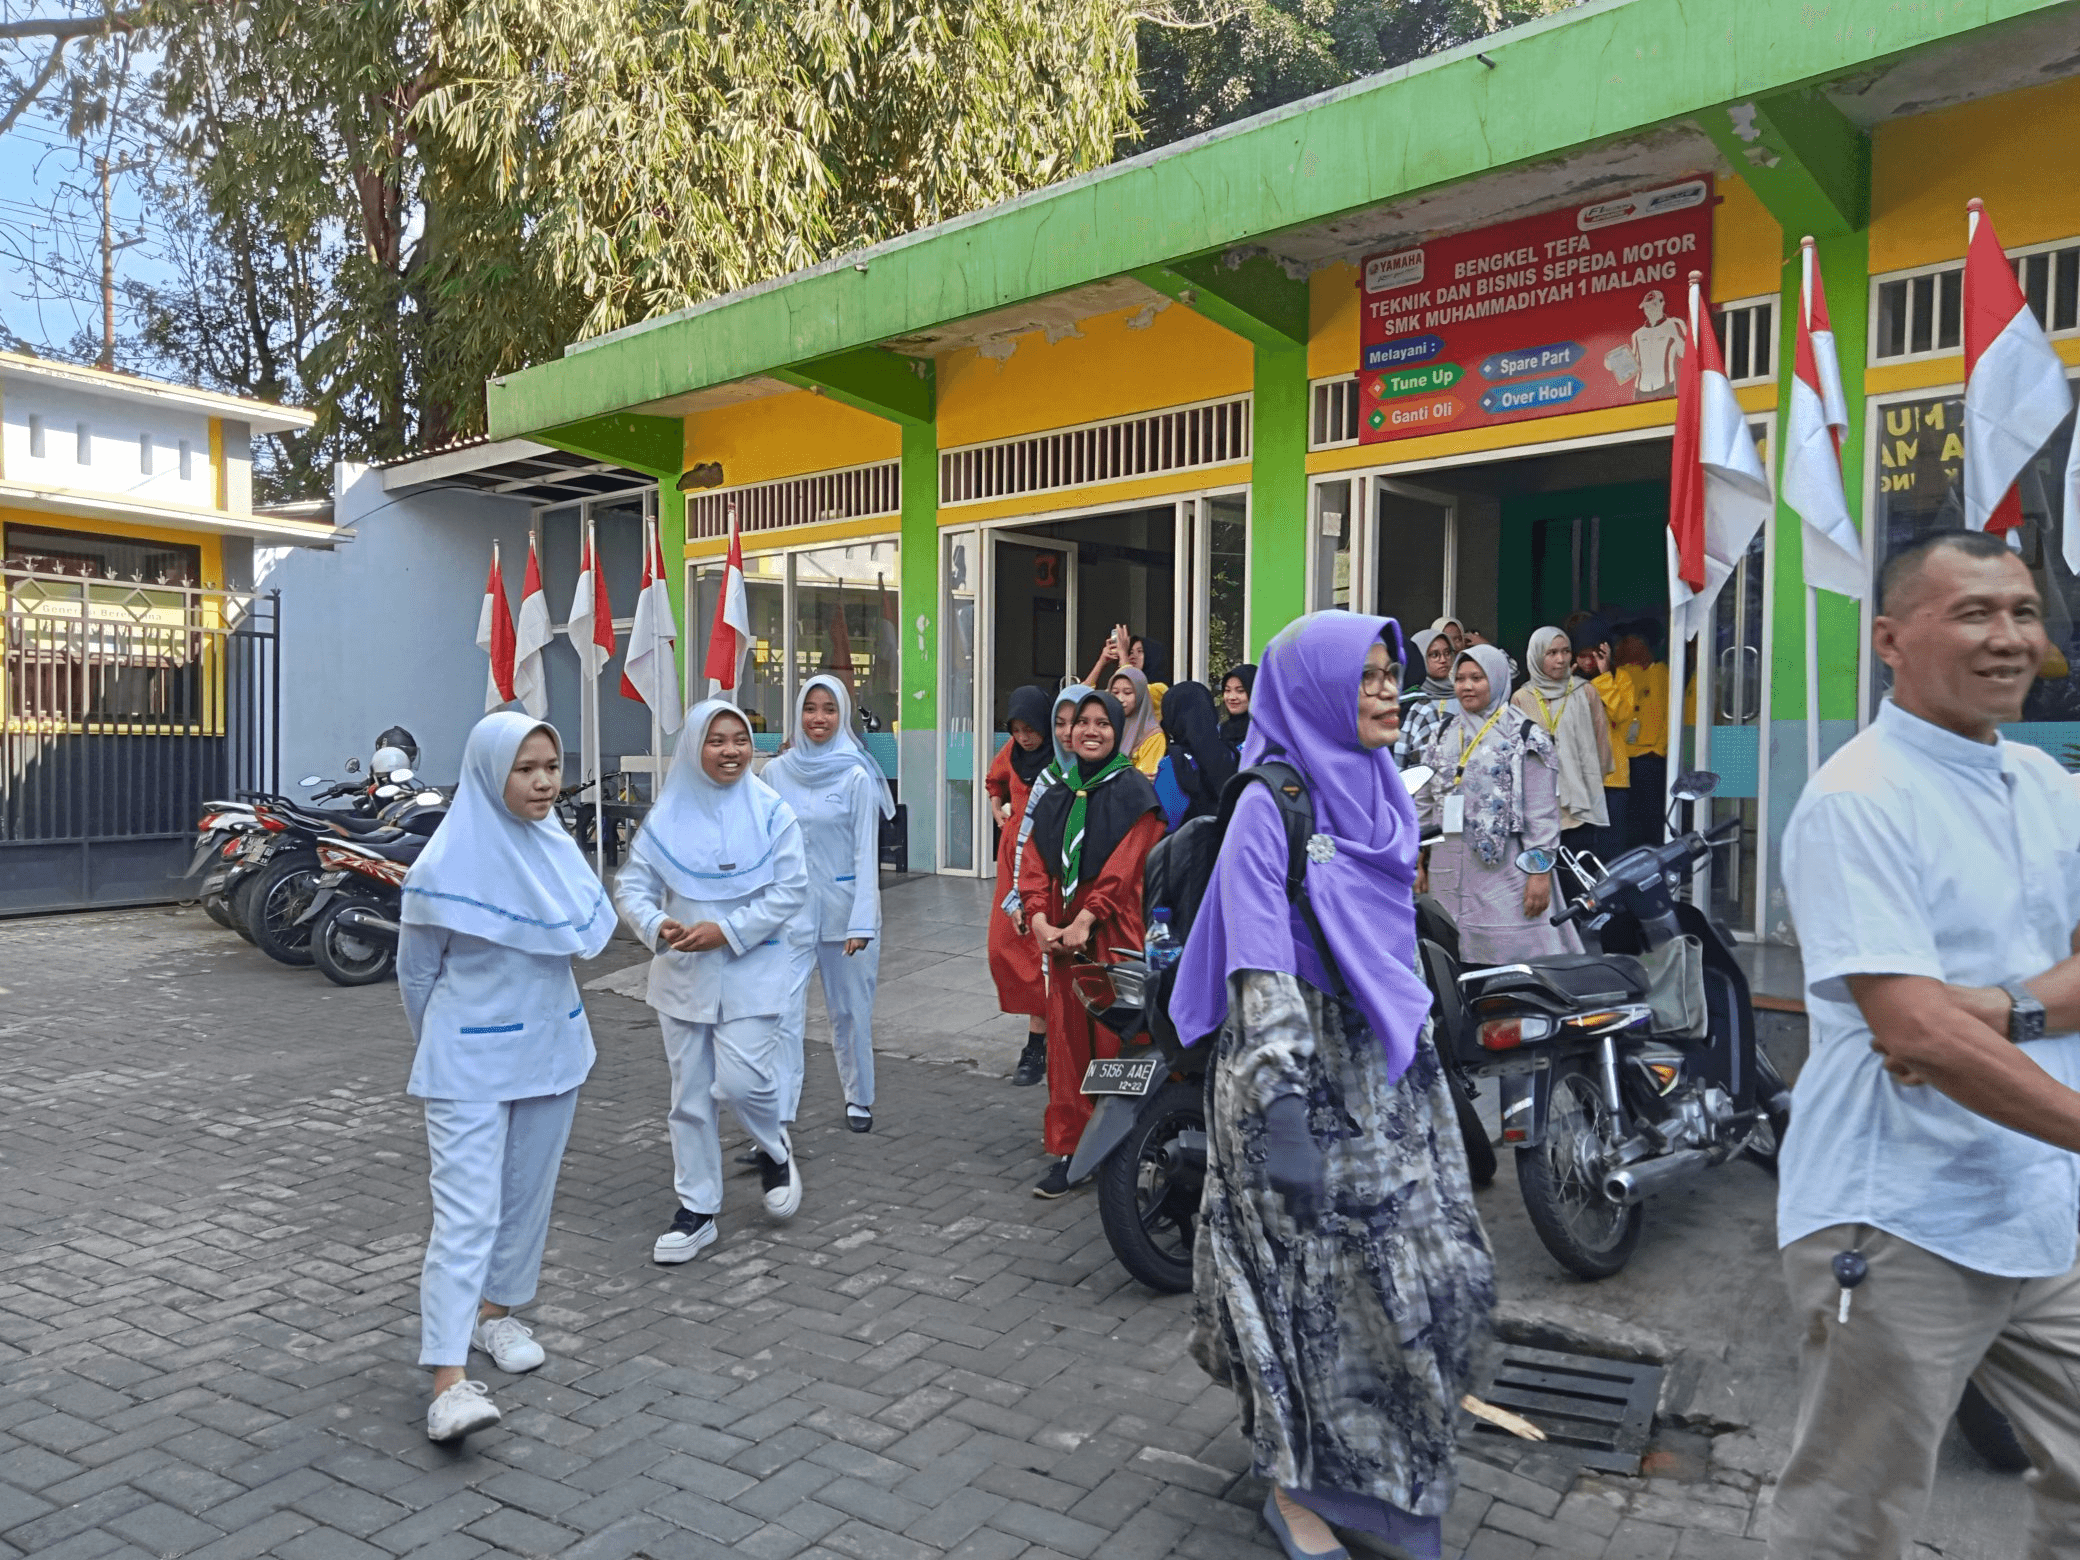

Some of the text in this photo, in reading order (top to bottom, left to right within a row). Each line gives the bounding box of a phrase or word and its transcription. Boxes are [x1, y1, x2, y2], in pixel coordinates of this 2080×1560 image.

[1380, 253, 1422, 273] YAMAHA
[1455, 234, 1591, 280] BENGKEL TEFA
[1369, 290, 1431, 319] TEKNIK
[1436, 282, 1471, 305] DAN
[1476, 268, 1537, 296] BISNIS
[1543, 250, 1617, 282] SEPEDA
[1622, 233, 1696, 265] MOTOR
[1385, 313, 1421, 336] SMK
[1425, 281, 1574, 329] MUHAMMADIYAH
[1577, 278, 1587, 296] 1
[1591, 261, 1677, 294] MALANG
[1369, 341, 1427, 364] Melayani
[1500, 348, 1571, 375] Spare Part
[1391, 369, 1454, 391] Tune Up
[1501, 381, 1572, 408] Over Houl
[1391, 402, 1453, 424] Ganti Oli
[1087, 1063, 1152, 1080] N 5156 AAE
